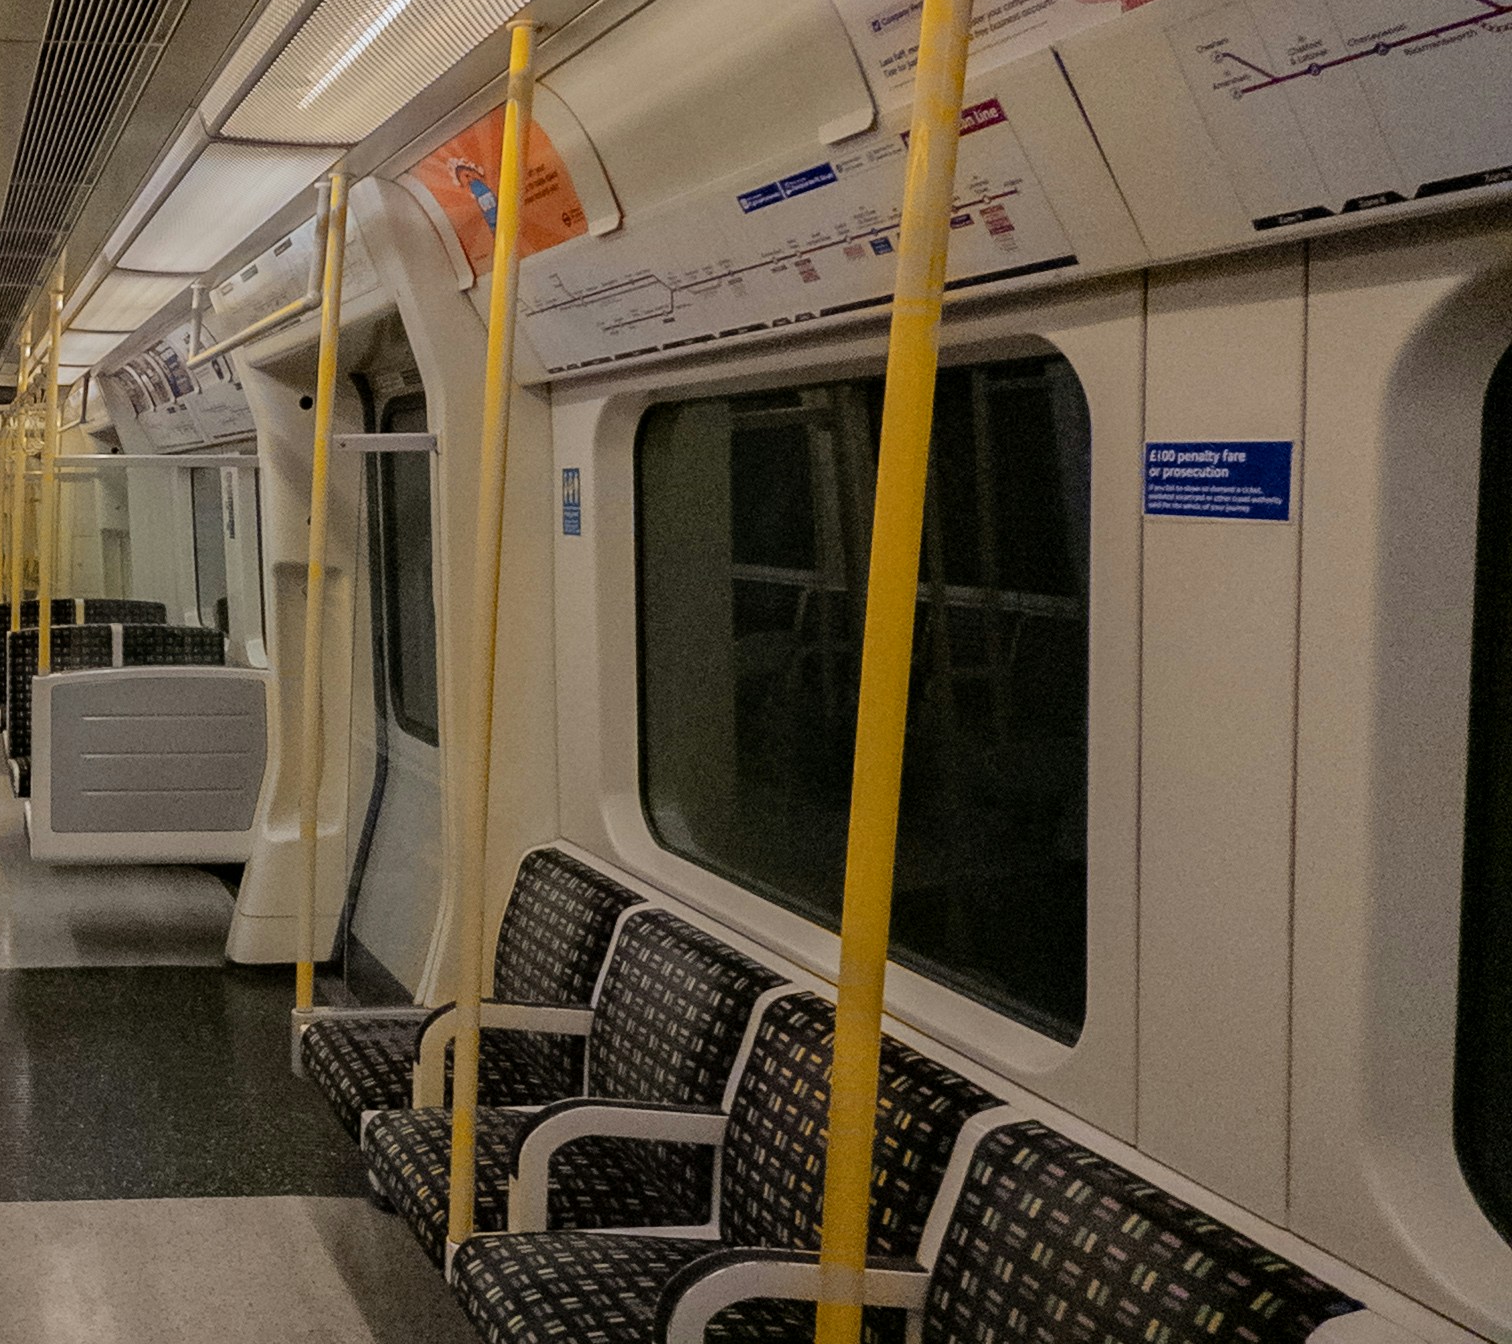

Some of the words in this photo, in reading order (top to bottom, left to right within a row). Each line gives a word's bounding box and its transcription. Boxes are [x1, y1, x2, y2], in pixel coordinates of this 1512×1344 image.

[1149, 449, 1176, 462] £100
[1177, 449, 1220, 465] penalty
[1222, 448, 1246, 463] fare
[1149, 467, 1161, 477] or
[1162, 465, 1229, 479] prosecution
